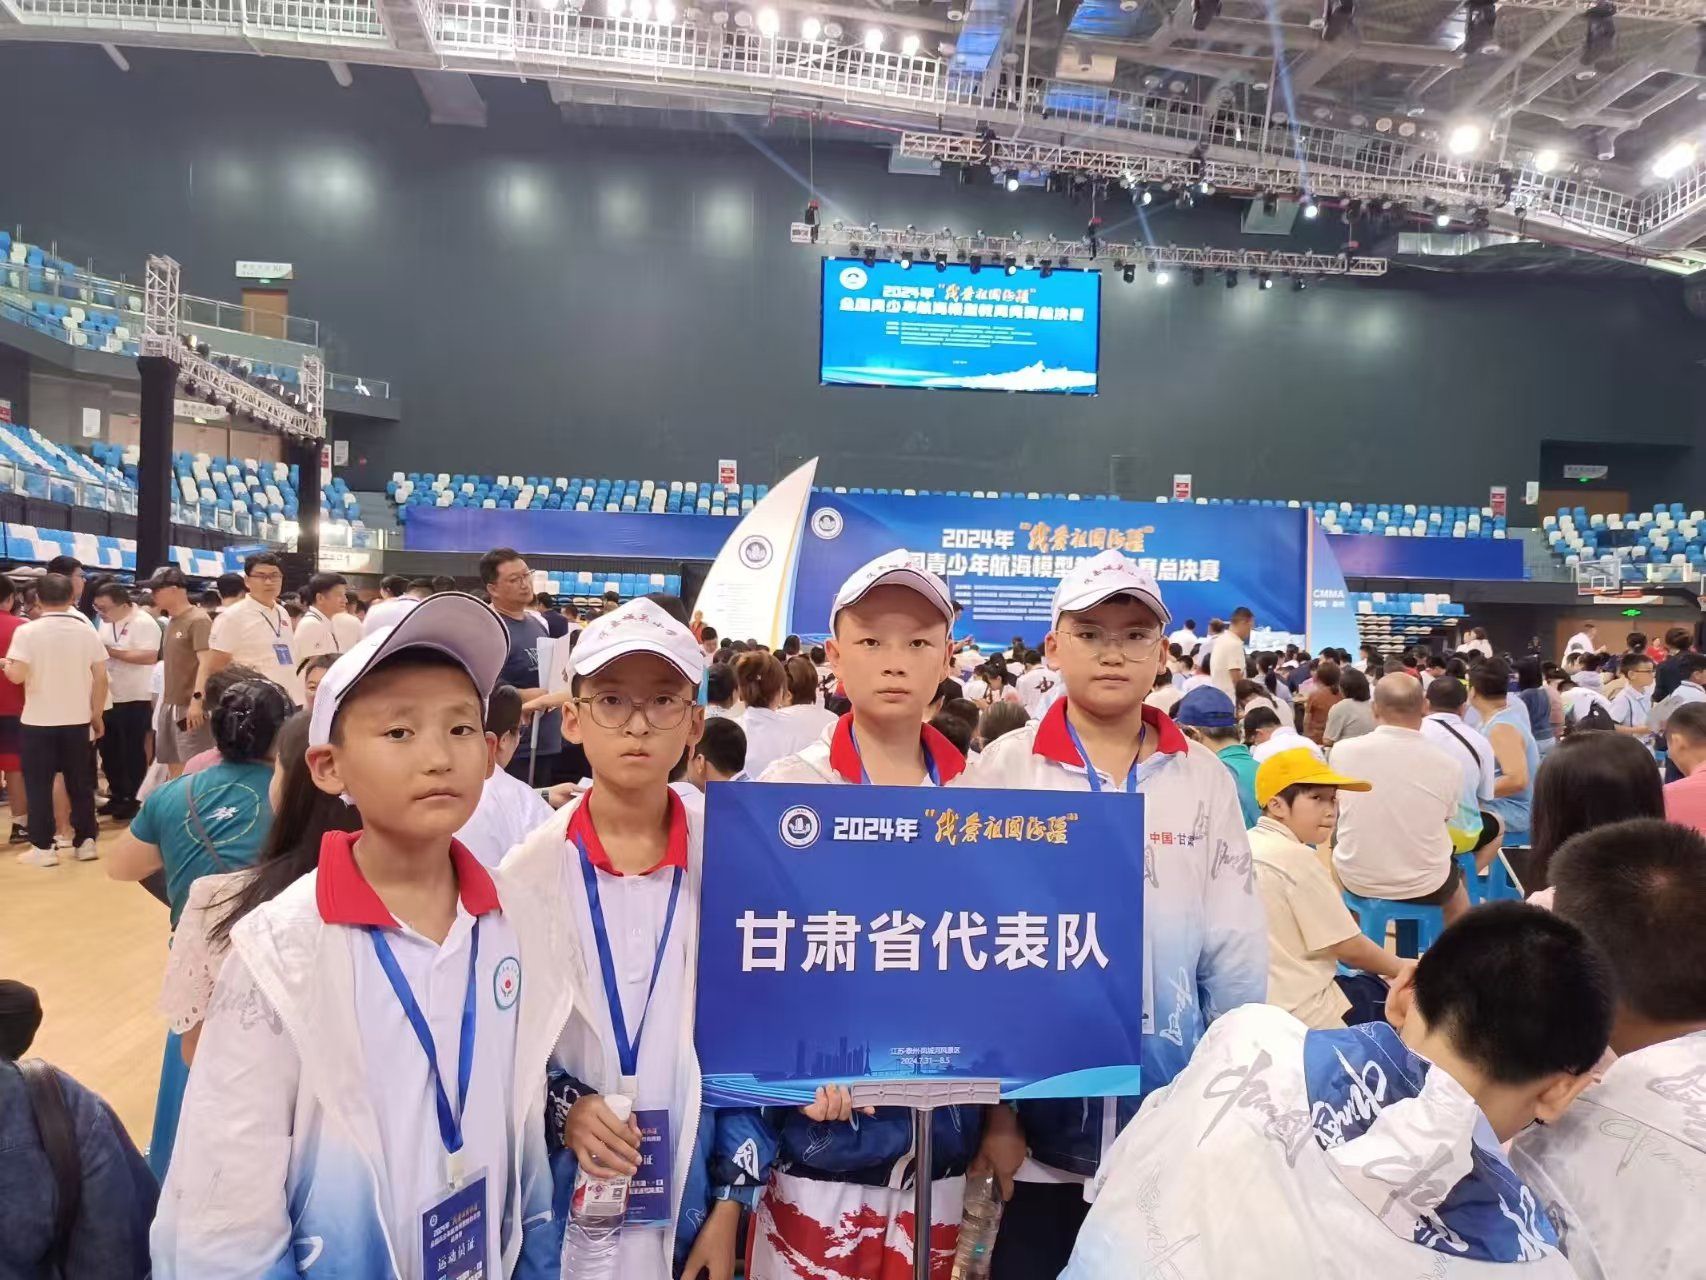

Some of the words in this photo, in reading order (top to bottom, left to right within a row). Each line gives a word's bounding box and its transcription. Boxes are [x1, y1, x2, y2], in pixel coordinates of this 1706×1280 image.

[942, 528, 1015, 549] 2024年
[1313, 589, 1344, 599] CMMA
[833, 816, 919, 842] 2024年
[735, 909, 1110, 972] 甘肃省代表队
